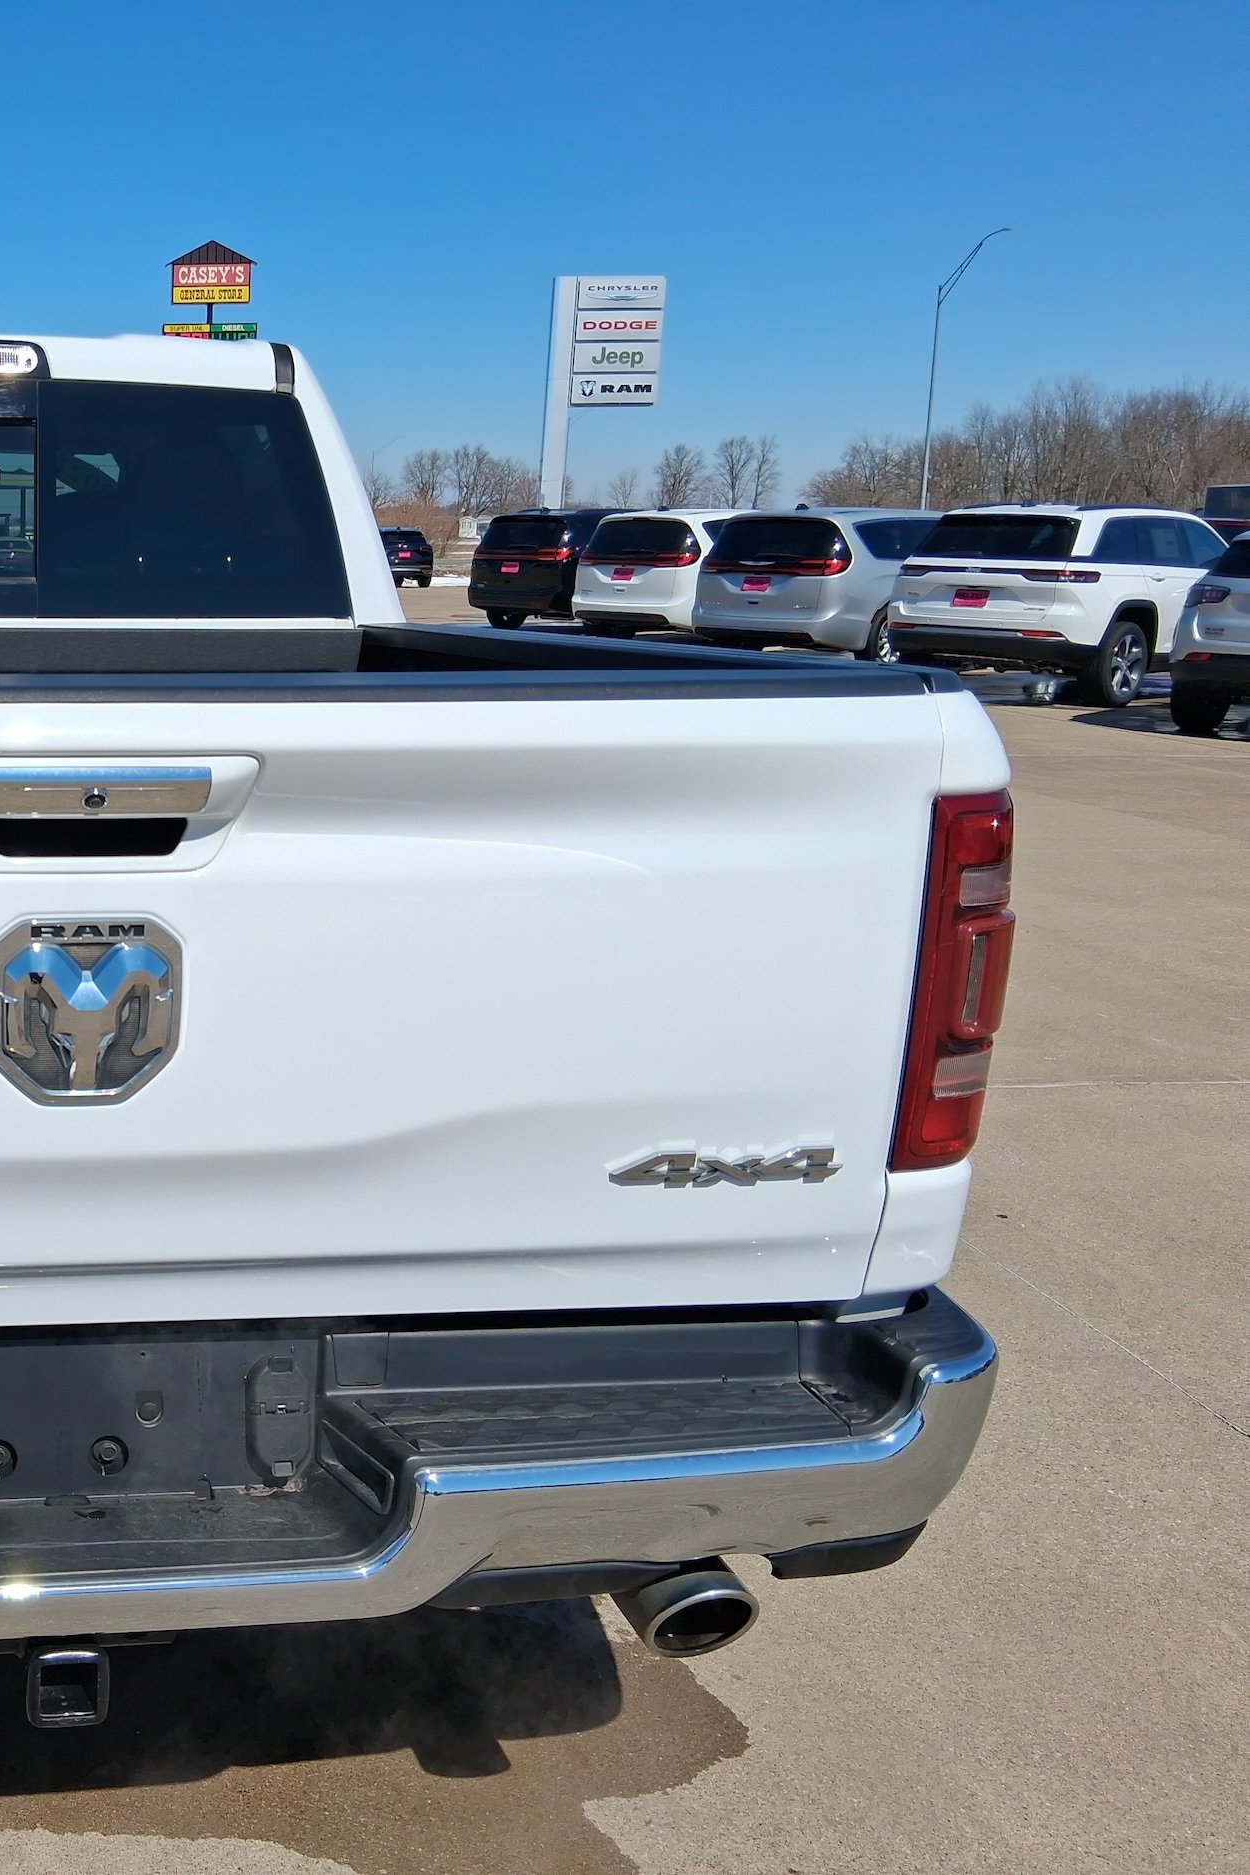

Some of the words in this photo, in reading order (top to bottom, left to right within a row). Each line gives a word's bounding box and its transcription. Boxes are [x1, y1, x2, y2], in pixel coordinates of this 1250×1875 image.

[179, 266, 245, 284] CASEY'S
[180, 290, 215, 301] GENERAL
[218, 289, 243, 300] STORE
[582, 321, 658, 331] DODGE
[592, 346, 644, 368] Jeep
[600, 384, 652, 393] RAM
[31, 924, 145, 940] RAM
